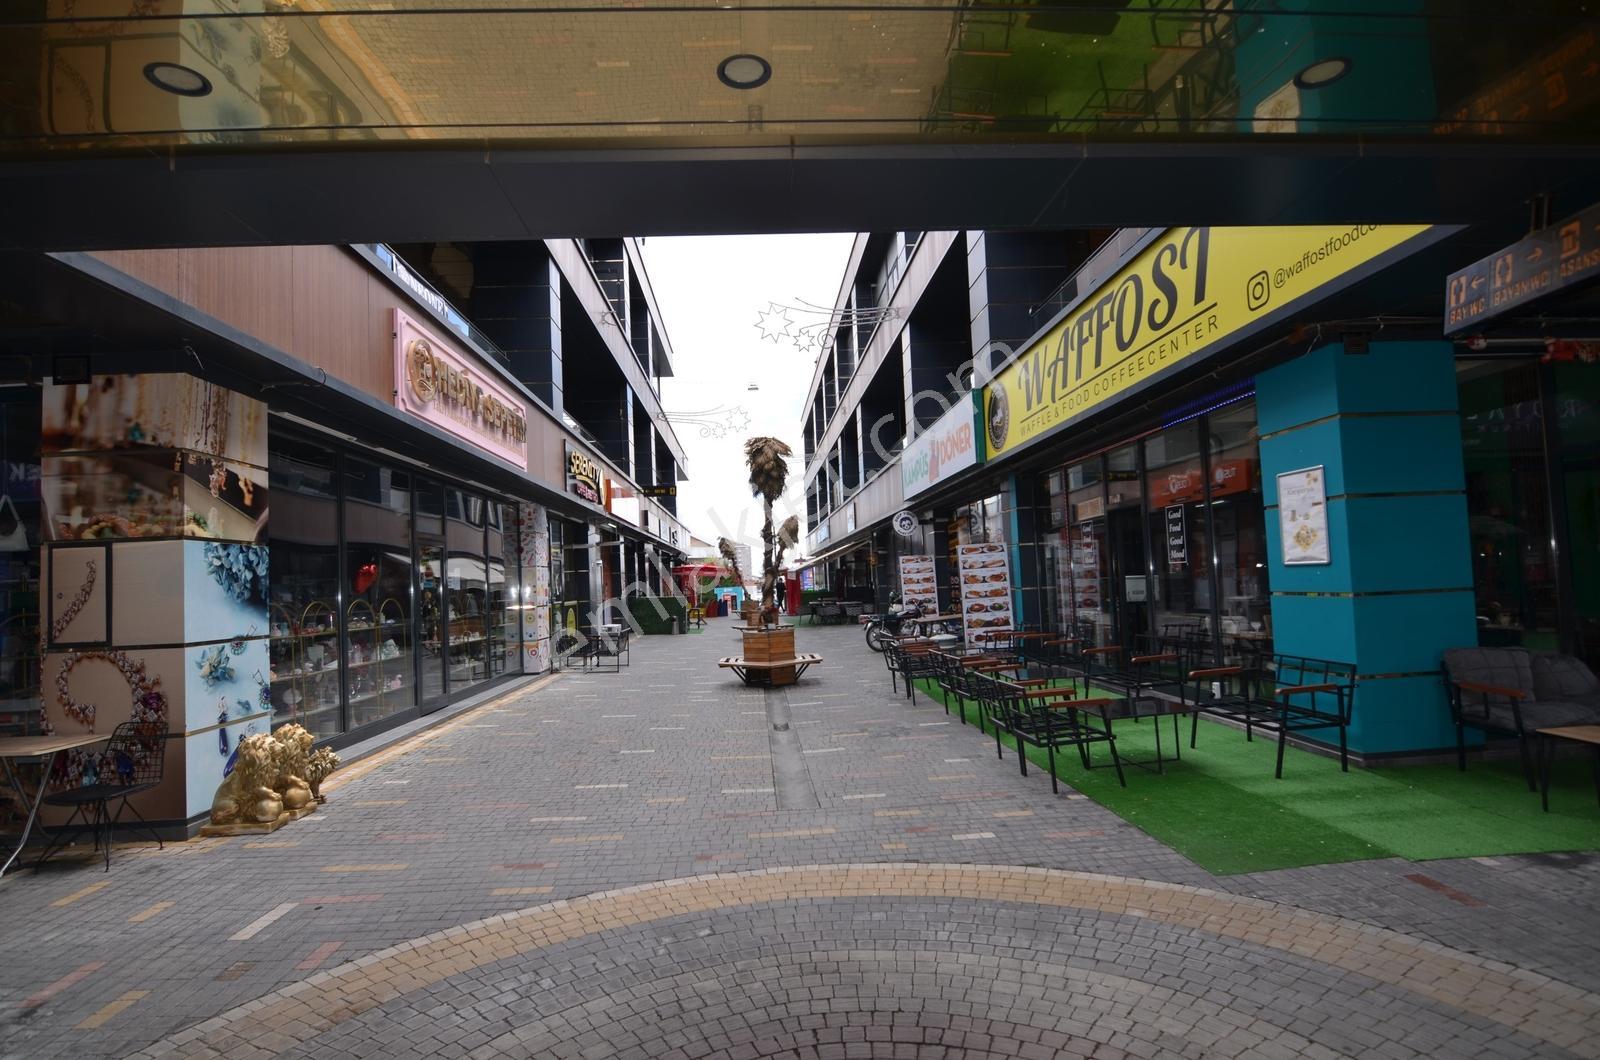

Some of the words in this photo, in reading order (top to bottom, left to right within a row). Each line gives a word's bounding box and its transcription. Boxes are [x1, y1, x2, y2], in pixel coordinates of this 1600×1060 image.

[1274, 225, 1383, 288] @waffostfoodco
[1018, 227, 1211, 412] WAFFOST
[1020, 413, 1053, 437] WAFFLE
[1062, 389, 1090, 416] FOOD
[940, 422, 972, 465] DÖNER
